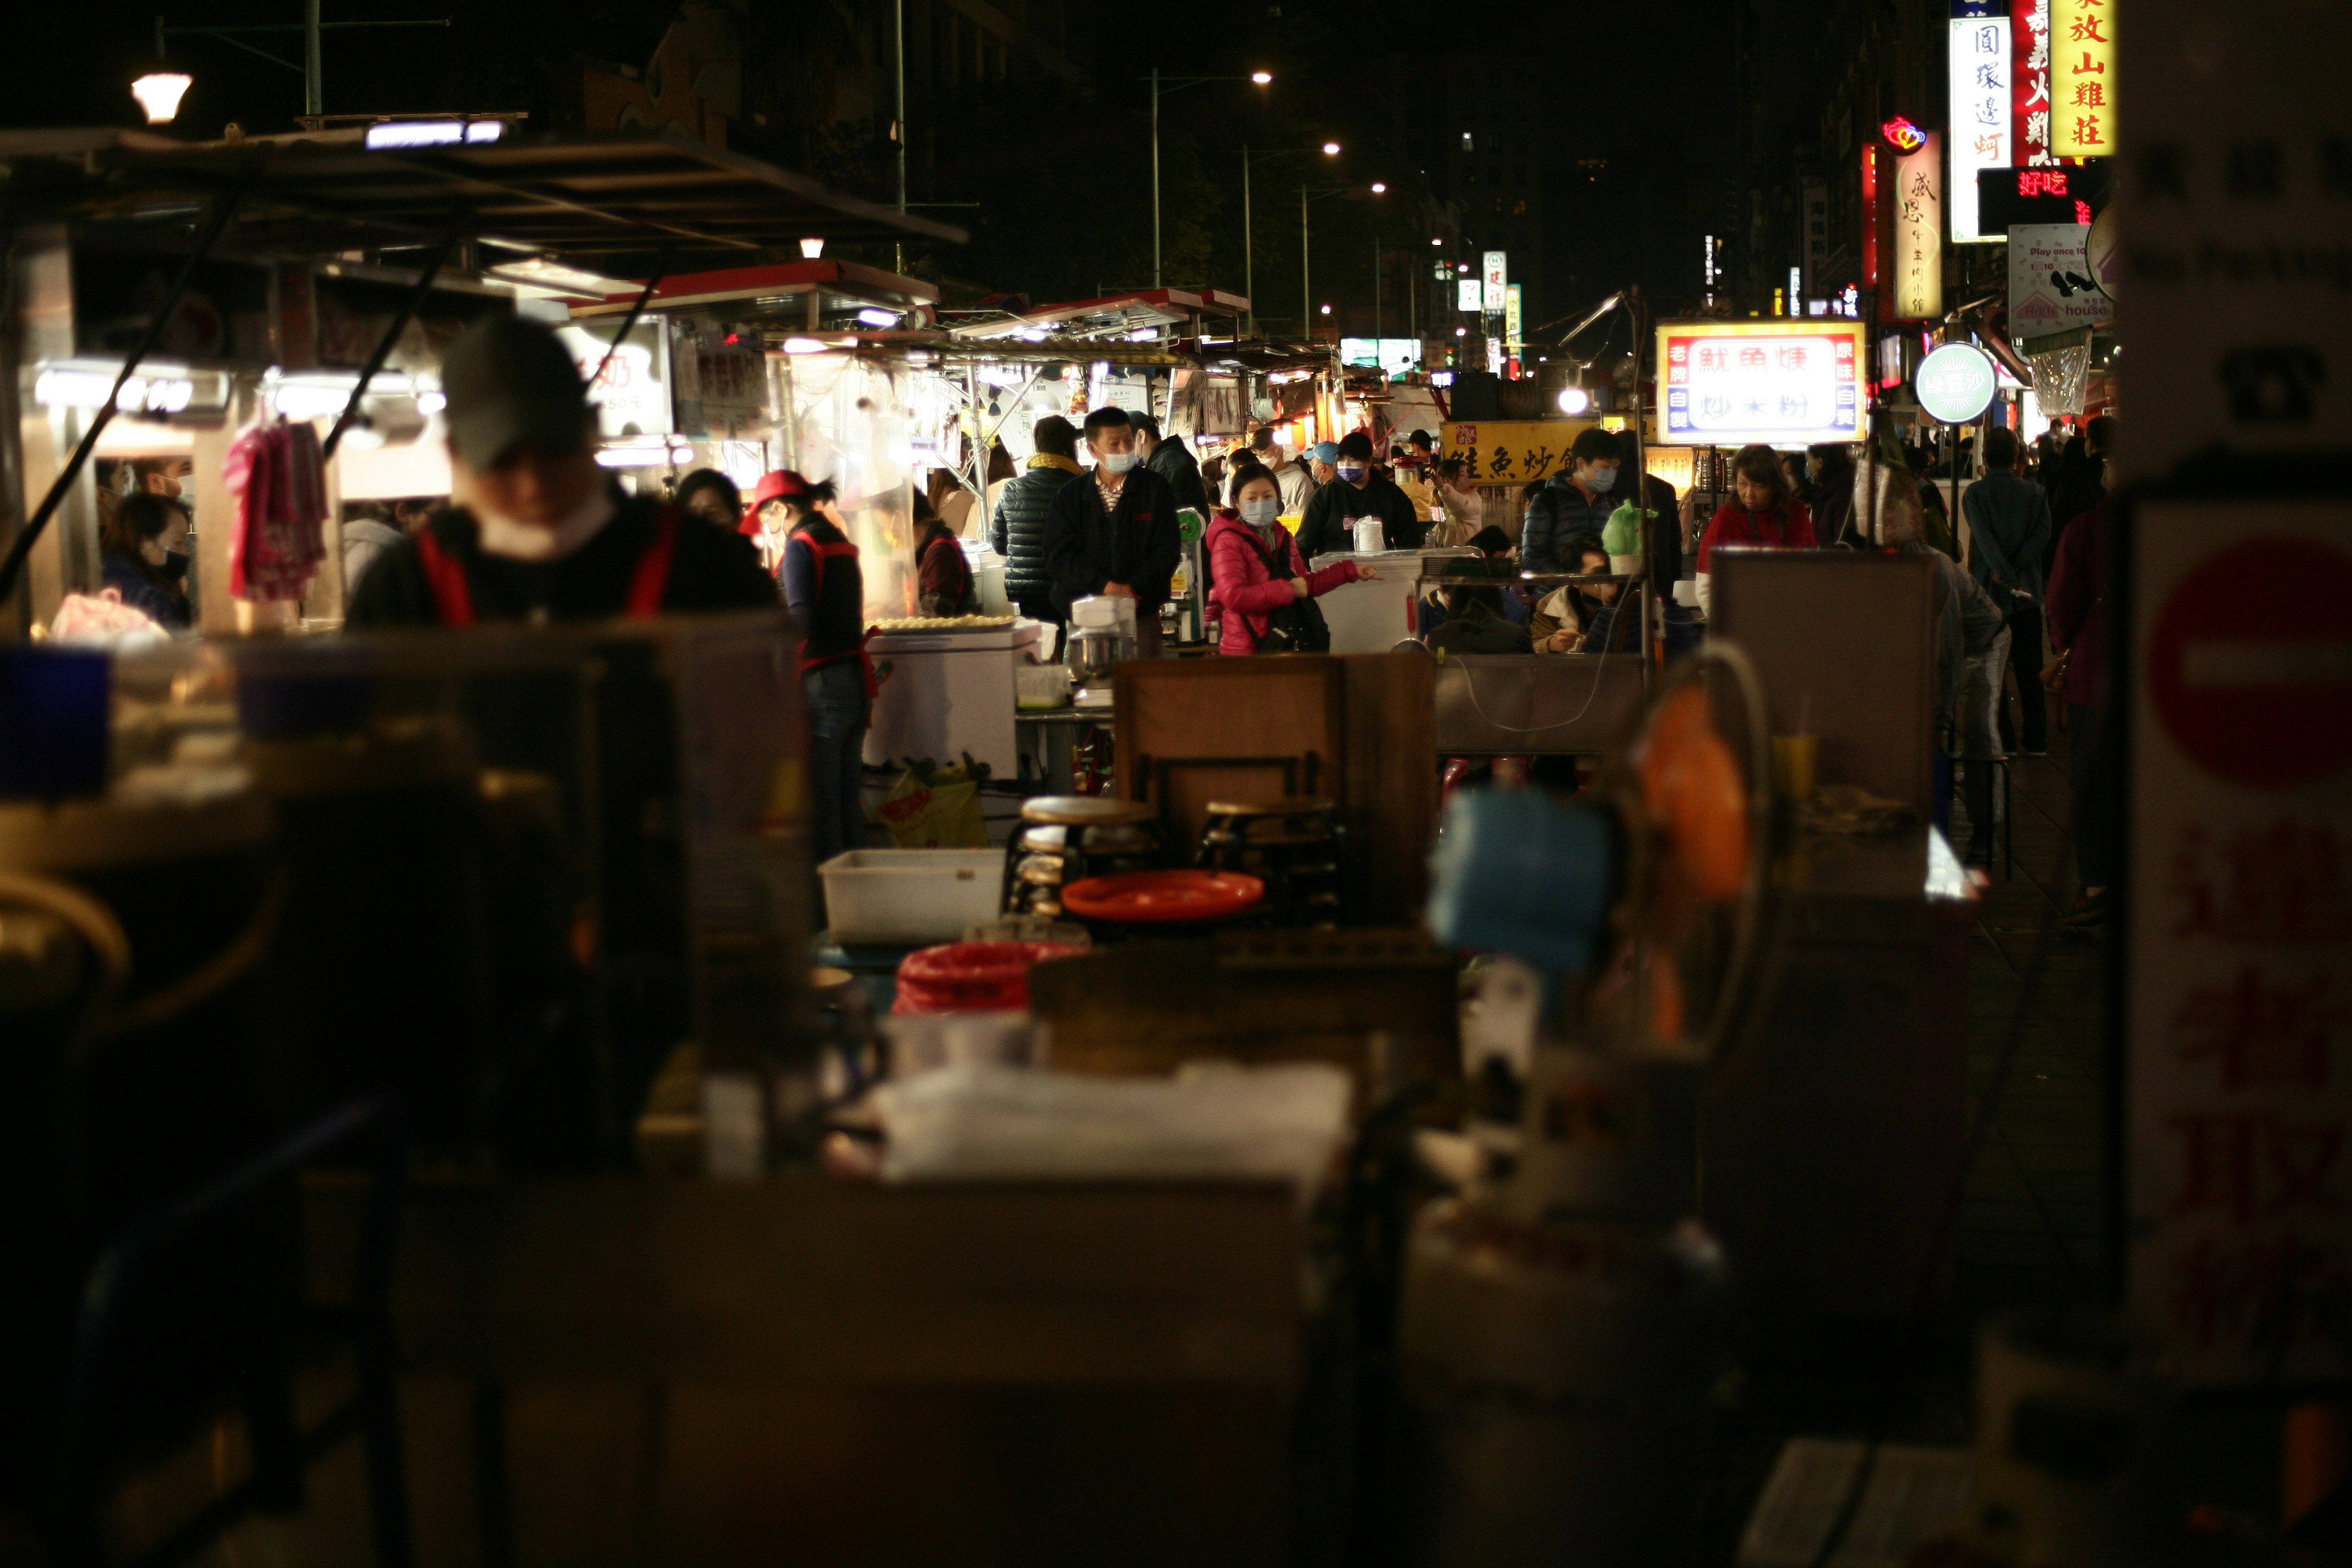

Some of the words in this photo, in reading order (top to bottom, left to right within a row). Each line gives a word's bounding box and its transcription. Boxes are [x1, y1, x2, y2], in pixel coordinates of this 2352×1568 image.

[2019, 172, 2067, 195] 好吃
[2031, 248, 2050, 256] Play
[2026, 306, 2055, 316] Rich
[2066, 305, 2108, 316] house
[1670, 346, 1688, 382] 老牌
[1837, 342, 1854, 379] 原味
[1924, 370, 1986, 395] 綠豆沙
[1670, 392, 1688, 428] 自製
[1700, 394, 1809, 419] 炒米粉
[1837, 389, 1854, 425] 自賣
